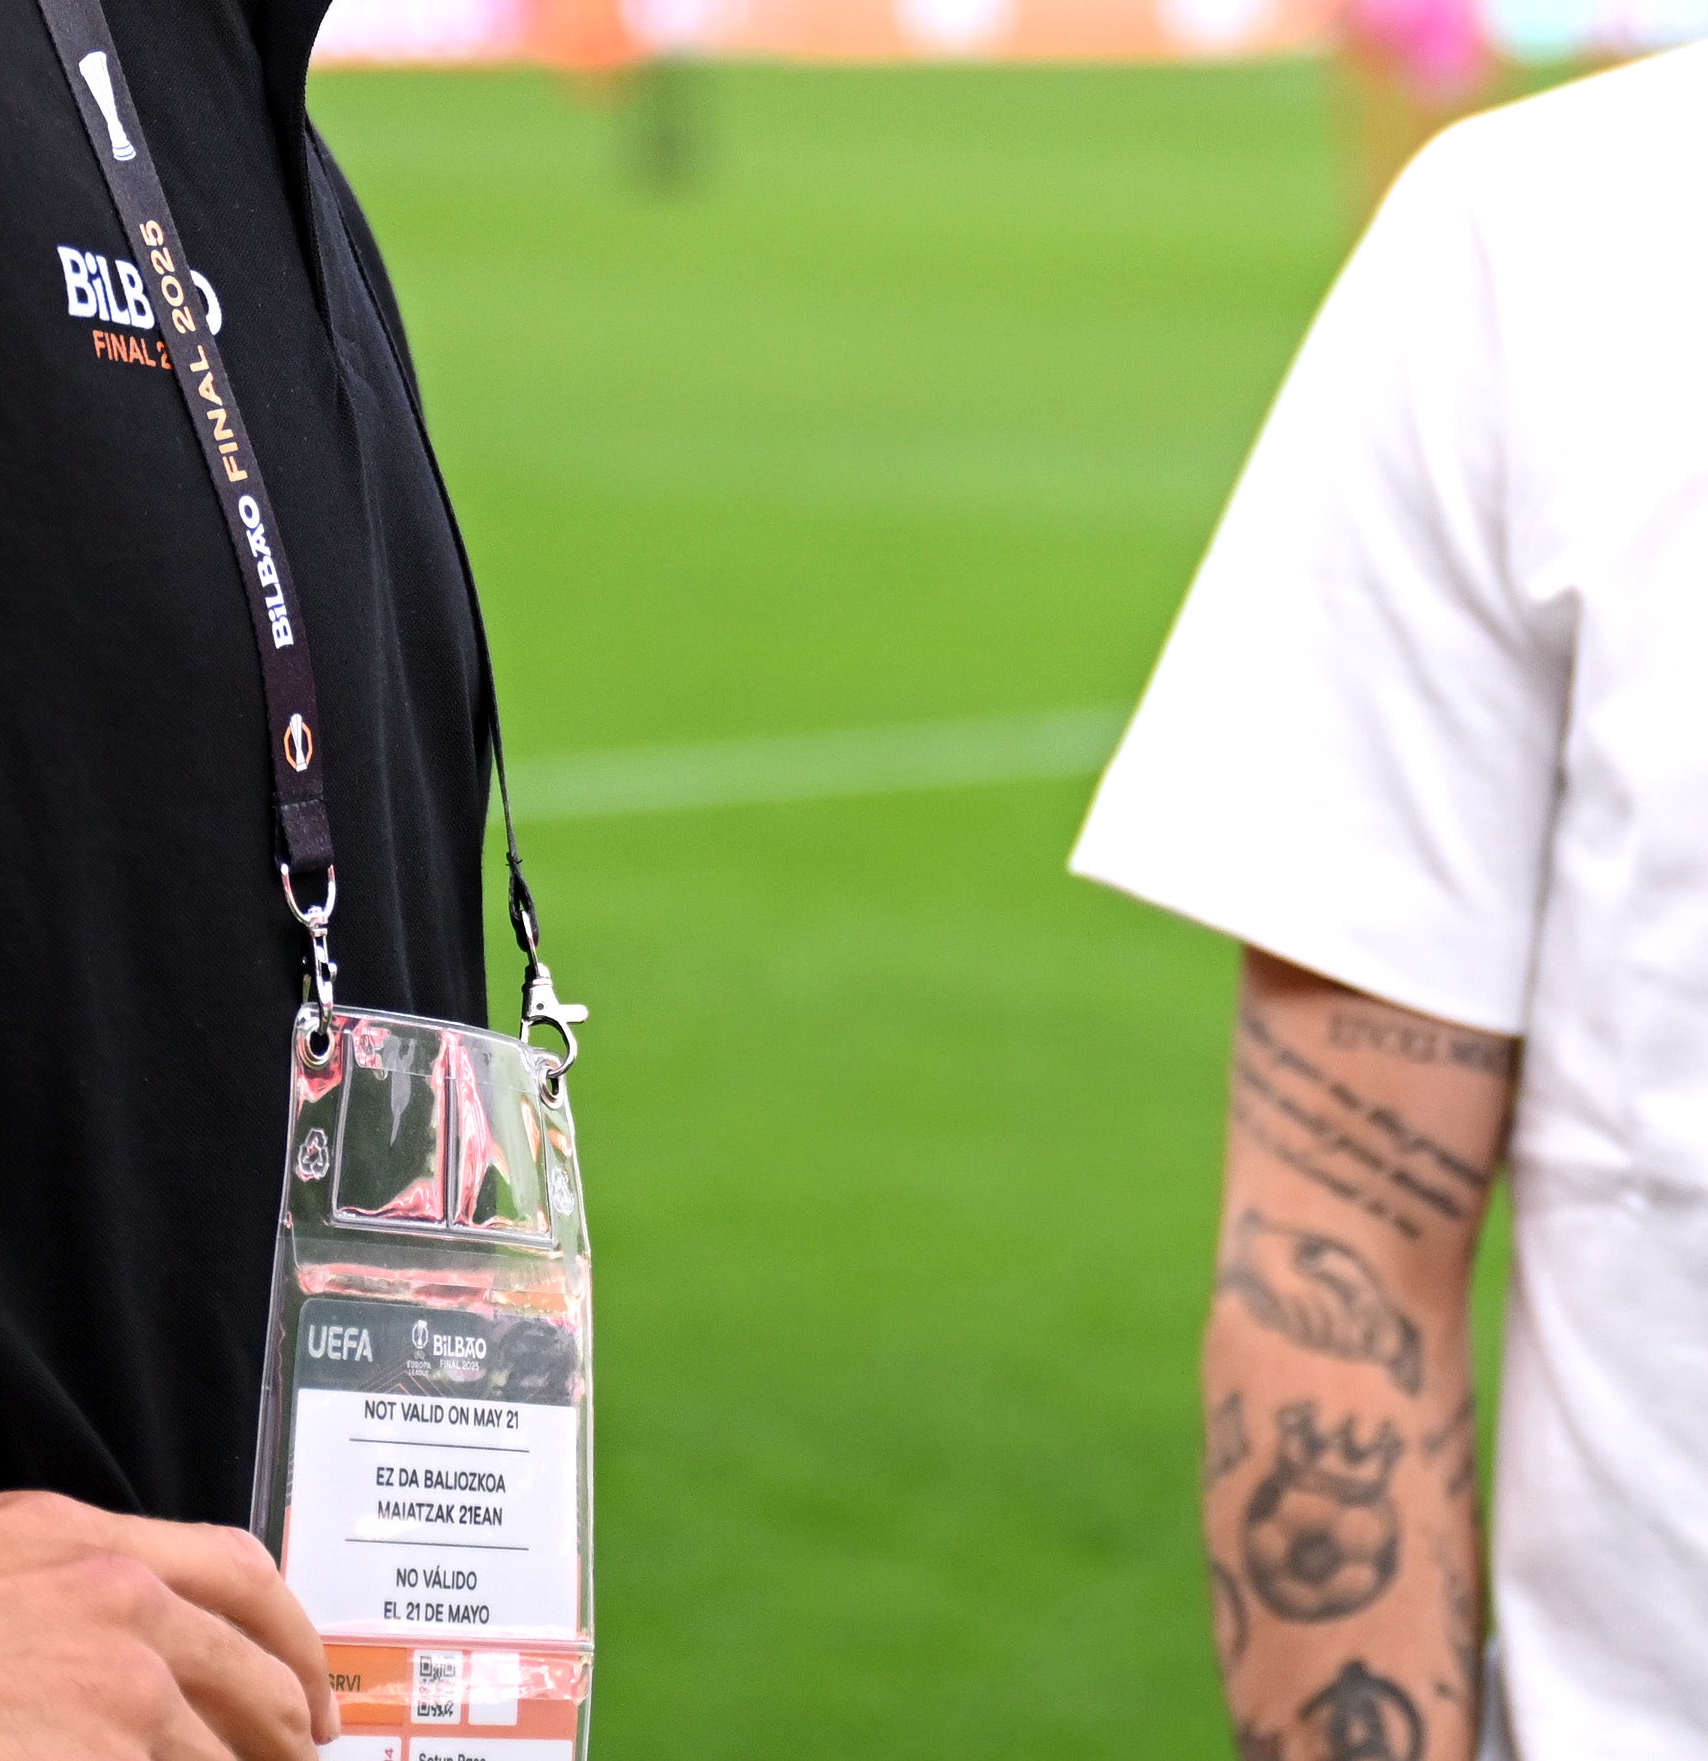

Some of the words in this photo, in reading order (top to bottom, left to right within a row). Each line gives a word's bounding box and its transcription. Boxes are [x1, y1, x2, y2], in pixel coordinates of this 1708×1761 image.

[139, 219, 197, 334] 2025
[93, 329, 157, 367] FINAL
[189, 345, 249, 482] FINAL
[307, 1325, 373, 1362] UEFA
[439, 1359, 460, 1370] FINAL
[461, 1360, 480, 1371] 2025
[364, 1400, 396, 1420] NOT
[401, 1403, 444, 1424] VALID
[448, 1406, 469, 1426] ON
[474, 1408, 503, 1428] MAY
[506, 1410, 519, 1429] 21
[376, 1467, 394, 1487] EZ
[399, 1468, 419, 1488] DA
[424, 1470, 506, 1493] BALIOZKOA
[378, 1500, 454, 1524] MAIATZAK
[459, 1505, 503, 1526] 21EAN
[396, 1568, 418, 1588] NO
[423, 1565, 477, 1590] VÁLIDO
[384, 1601, 401, 1620] EL
[406, 1602, 420, 1621] 21
[425, 1603, 444, 1623] DE
[448, 1604, 490, 1624] MAYO
